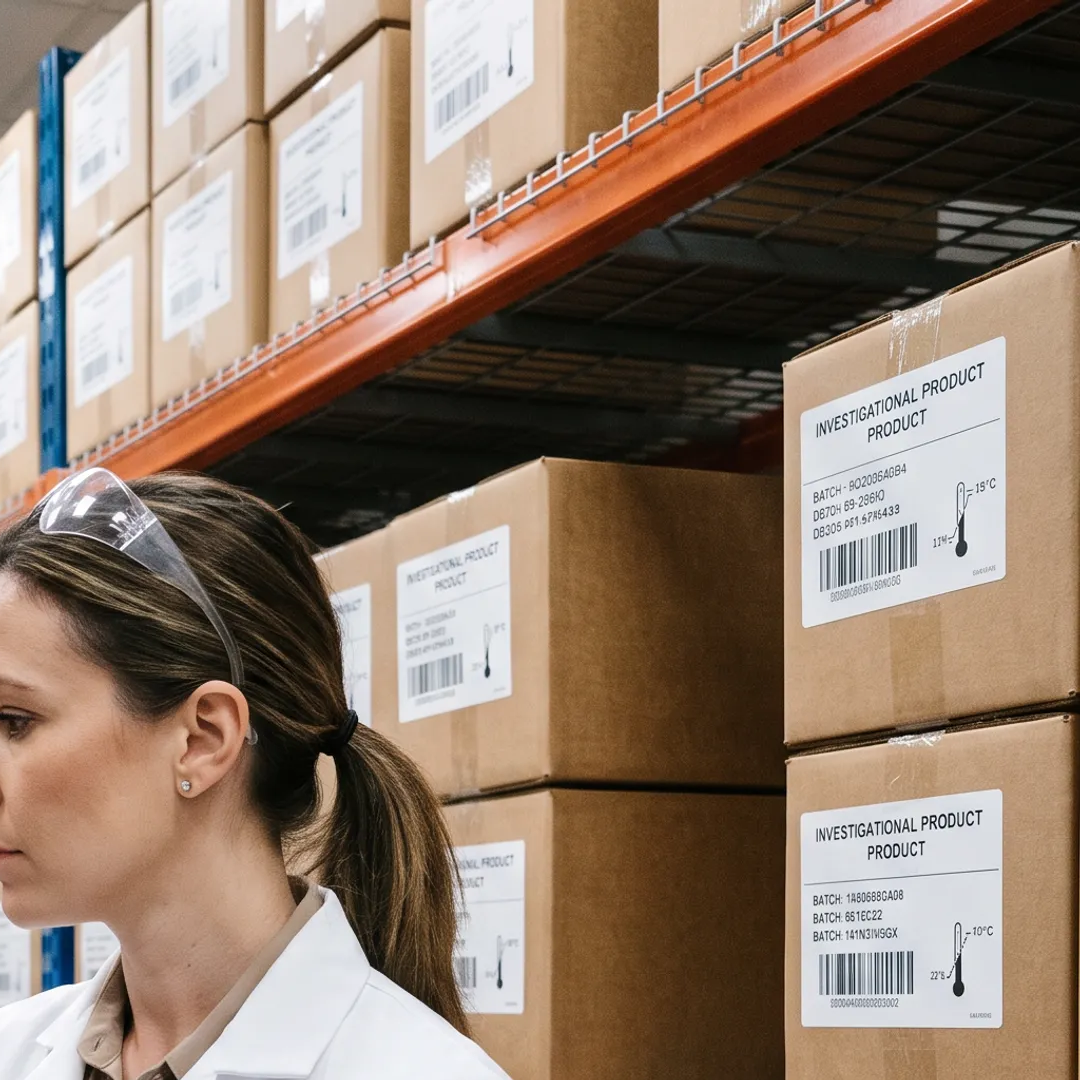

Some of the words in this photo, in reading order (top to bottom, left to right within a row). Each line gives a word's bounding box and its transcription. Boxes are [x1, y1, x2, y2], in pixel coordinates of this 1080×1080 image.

[815, 387, 918, 439] INVESTIGATIONAL
[921, 361, 986, 400] PRODUCT
[867, 408, 928, 443] PRODUCT
[813, 484, 842, 504] BATCH
[815, 817, 918, 843] INVESTIGATIONAL
[920, 809, 984, 832] PRODUCT
[867, 841, 926, 860] PRODUCT
[813, 894, 843, 906] BATCH:
[813, 912, 843, 924] BATCH:
[813, 930, 843, 942] BATCH:
